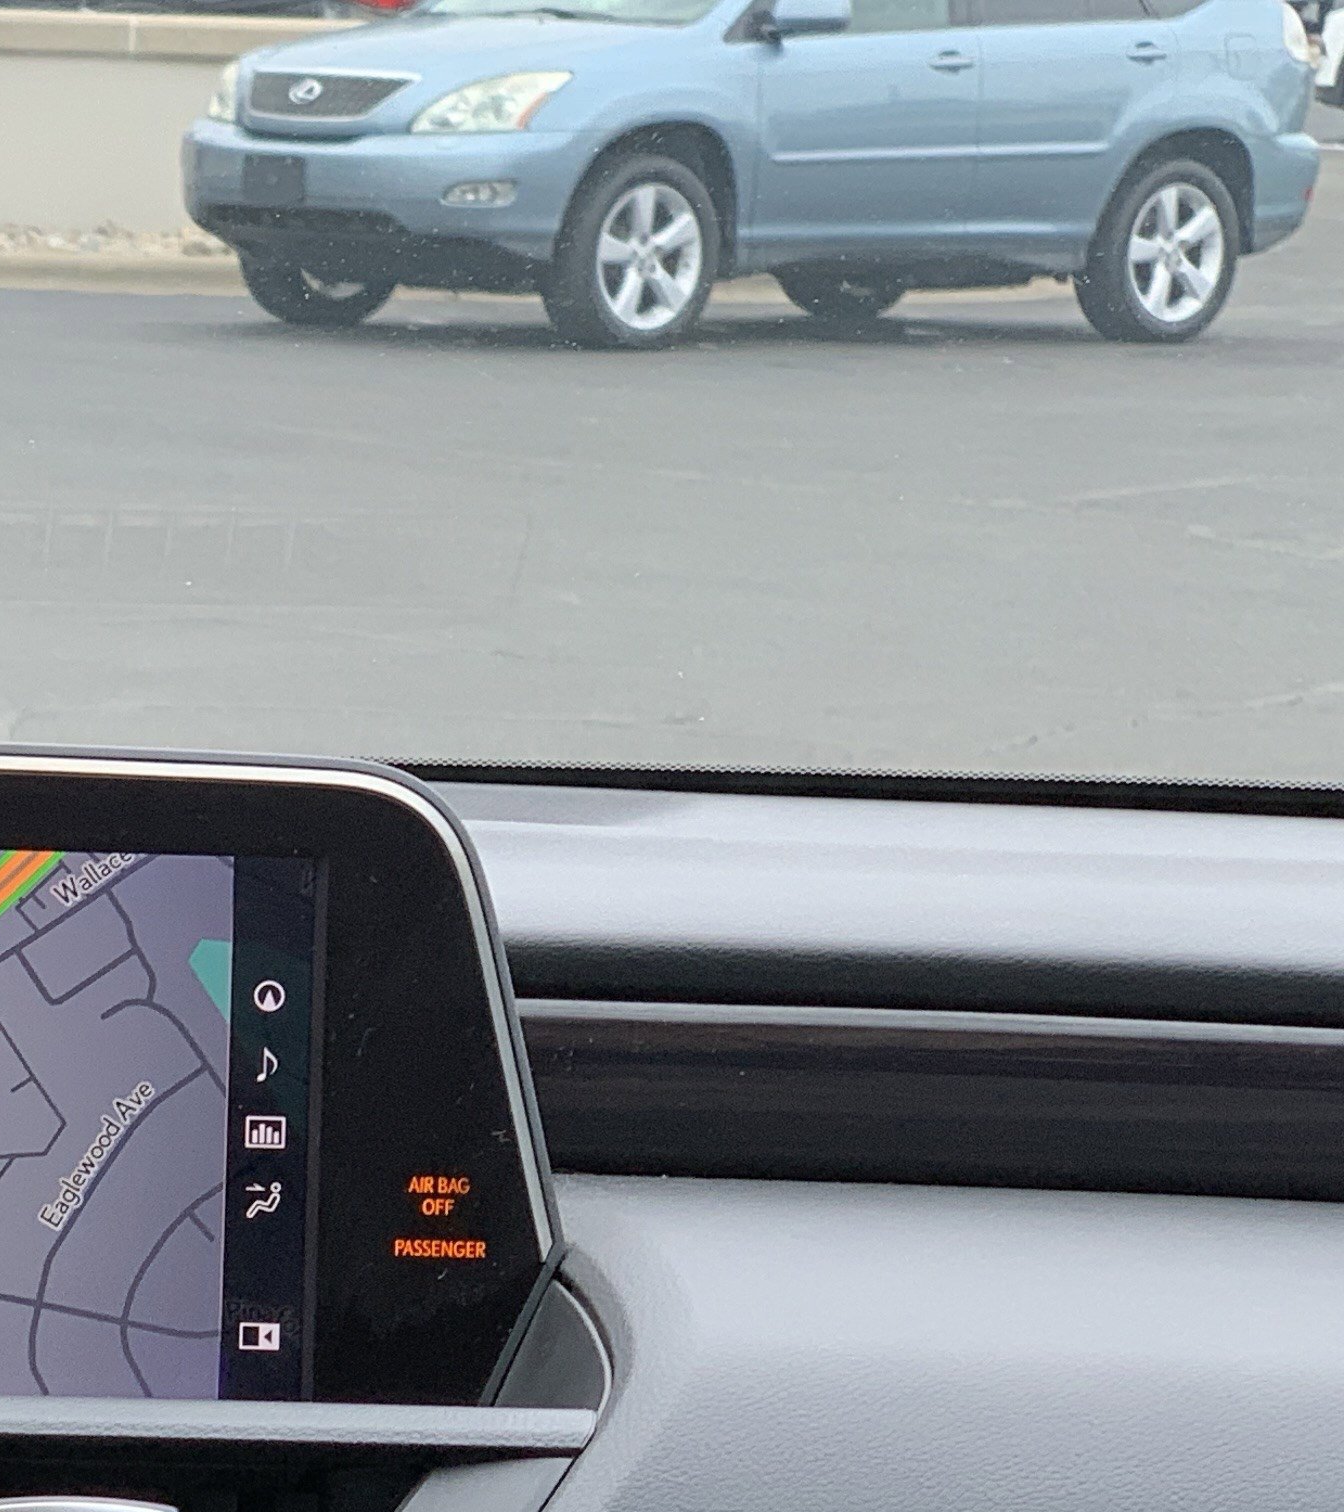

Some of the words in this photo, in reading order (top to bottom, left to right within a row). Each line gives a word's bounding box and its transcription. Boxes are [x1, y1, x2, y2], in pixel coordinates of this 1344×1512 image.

[39, 1119, 127, 1230] Eaglewood
[114, 1083, 153, 1120] Ave
[408, 1176, 433, 1193] AIR
[438, 1176, 470, 1194] BAG
[421, 1199, 454, 1216] OFF
[394, 1239, 486, 1258] PASSENGER
